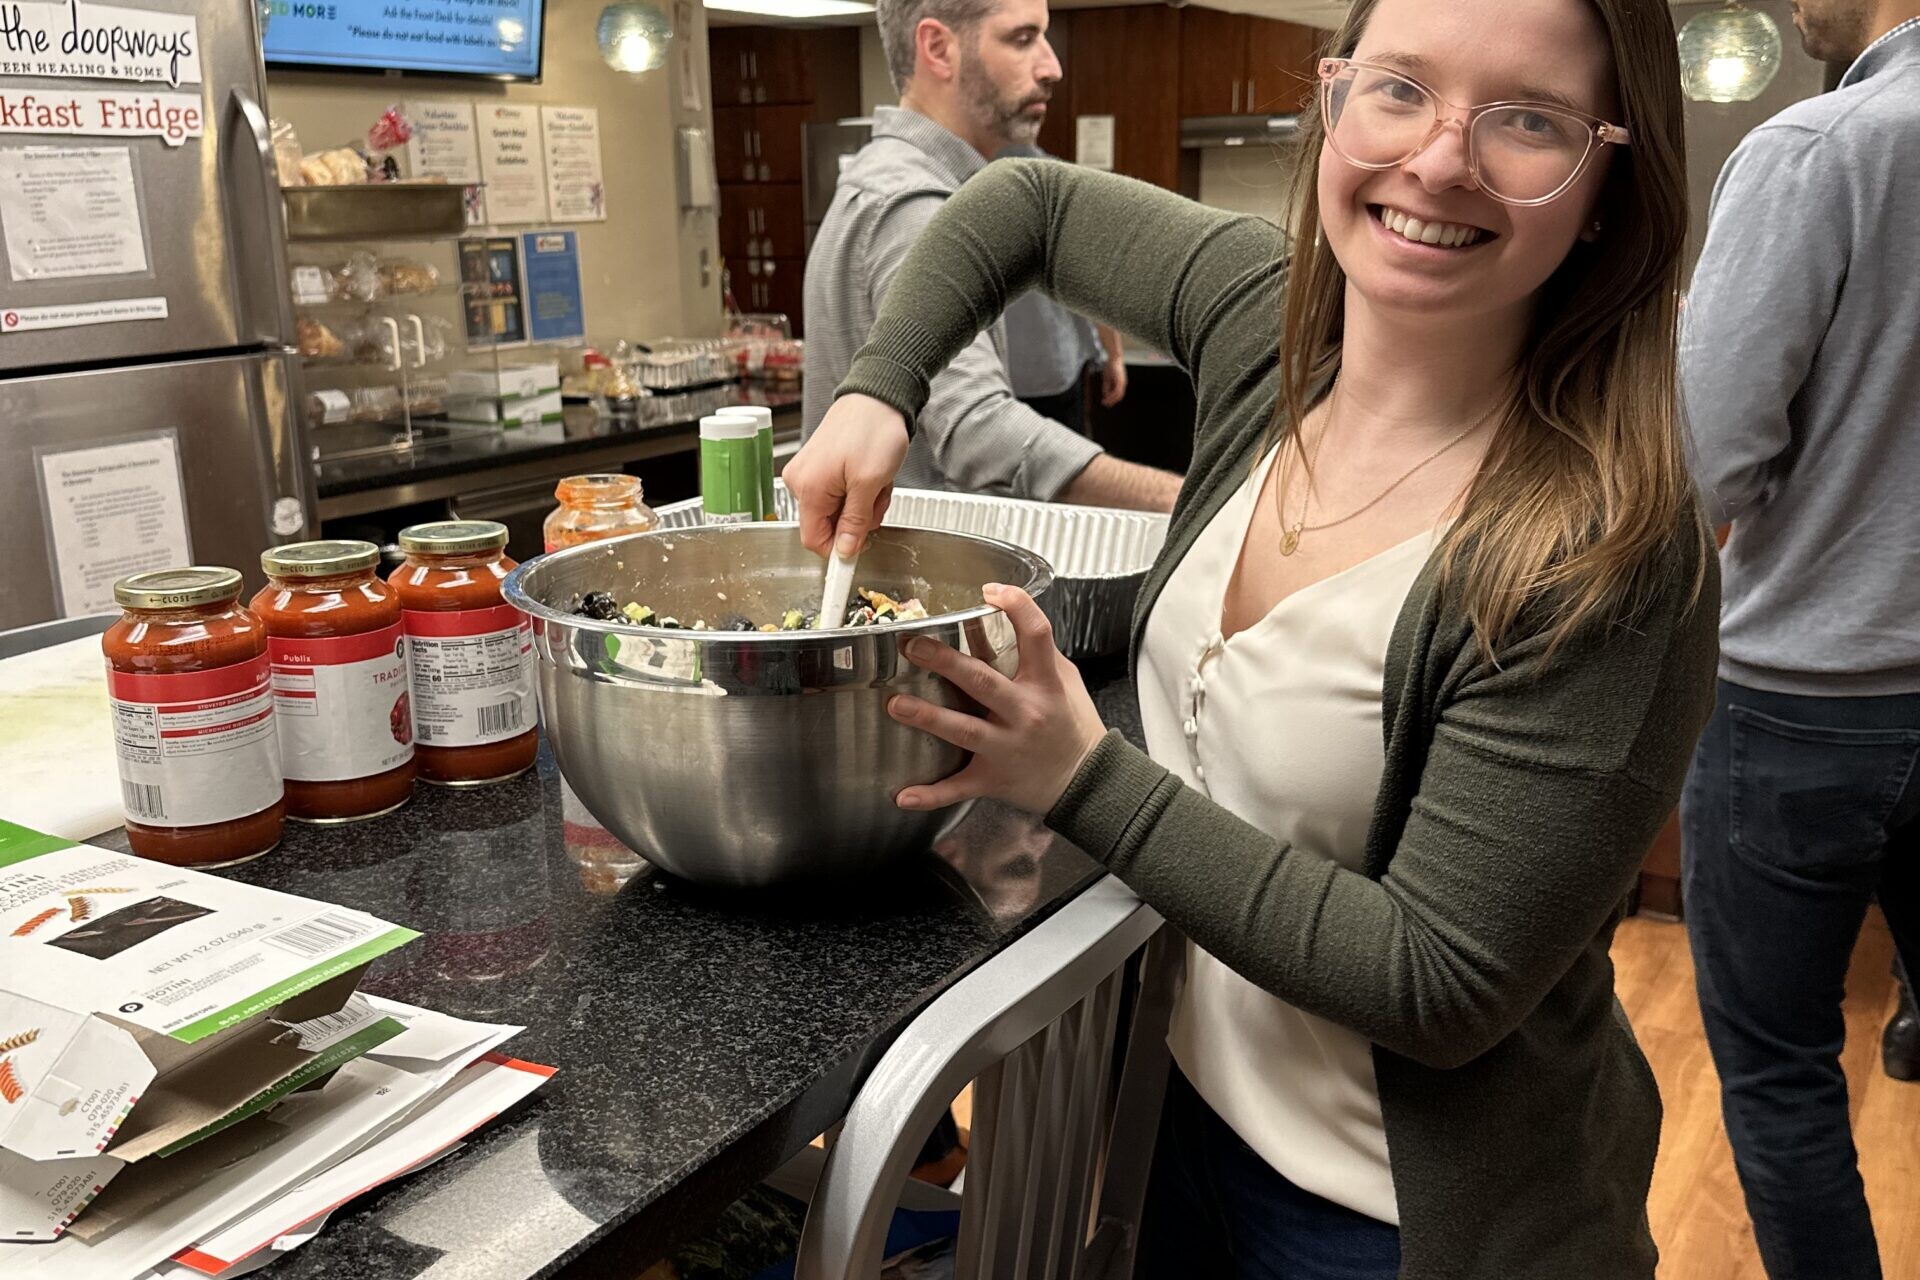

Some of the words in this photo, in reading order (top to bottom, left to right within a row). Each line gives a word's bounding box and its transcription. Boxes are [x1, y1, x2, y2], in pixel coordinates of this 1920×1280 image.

[293, 4, 336, 20] MORE
[0, 4, 50, 55] the
[61, 0, 192, 83] doorways
[0, 63, 31, 74] EEN
[37, 62, 106, 76] HEALING
[111, 65, 119, 75] &
[124, 66, 165, 78] HOME
[0, 95, 85, 128] kfast
[98, 97, 200, 139] Fridge
[290, 565, 314, 574] CLOSE
[162, 595, 190, 604] CLOSE
[411, 640, 439, 648] Nutrition
[283, 654, 311, 663] Publix
[197, 700, 226, 710] STOVETOP
[197, 724, 232, 735] MICROWAVE
[1, 885, 66, 913] ACARONI
[148, 958, 174, 975] NET
[175, 952, 195, 964] WT
[193, 945, 211, 955] 12
[209, 936, 229, 947] OZ
[146, 977, 192, 1001] ROTINI
[81, 1088, 102, 1114] CT001
[87, 1088, 115, 1122] Q79-020
[46, 1174, 70, 1198] CT001
[51, 1175, 82, 1206] Q79-020
